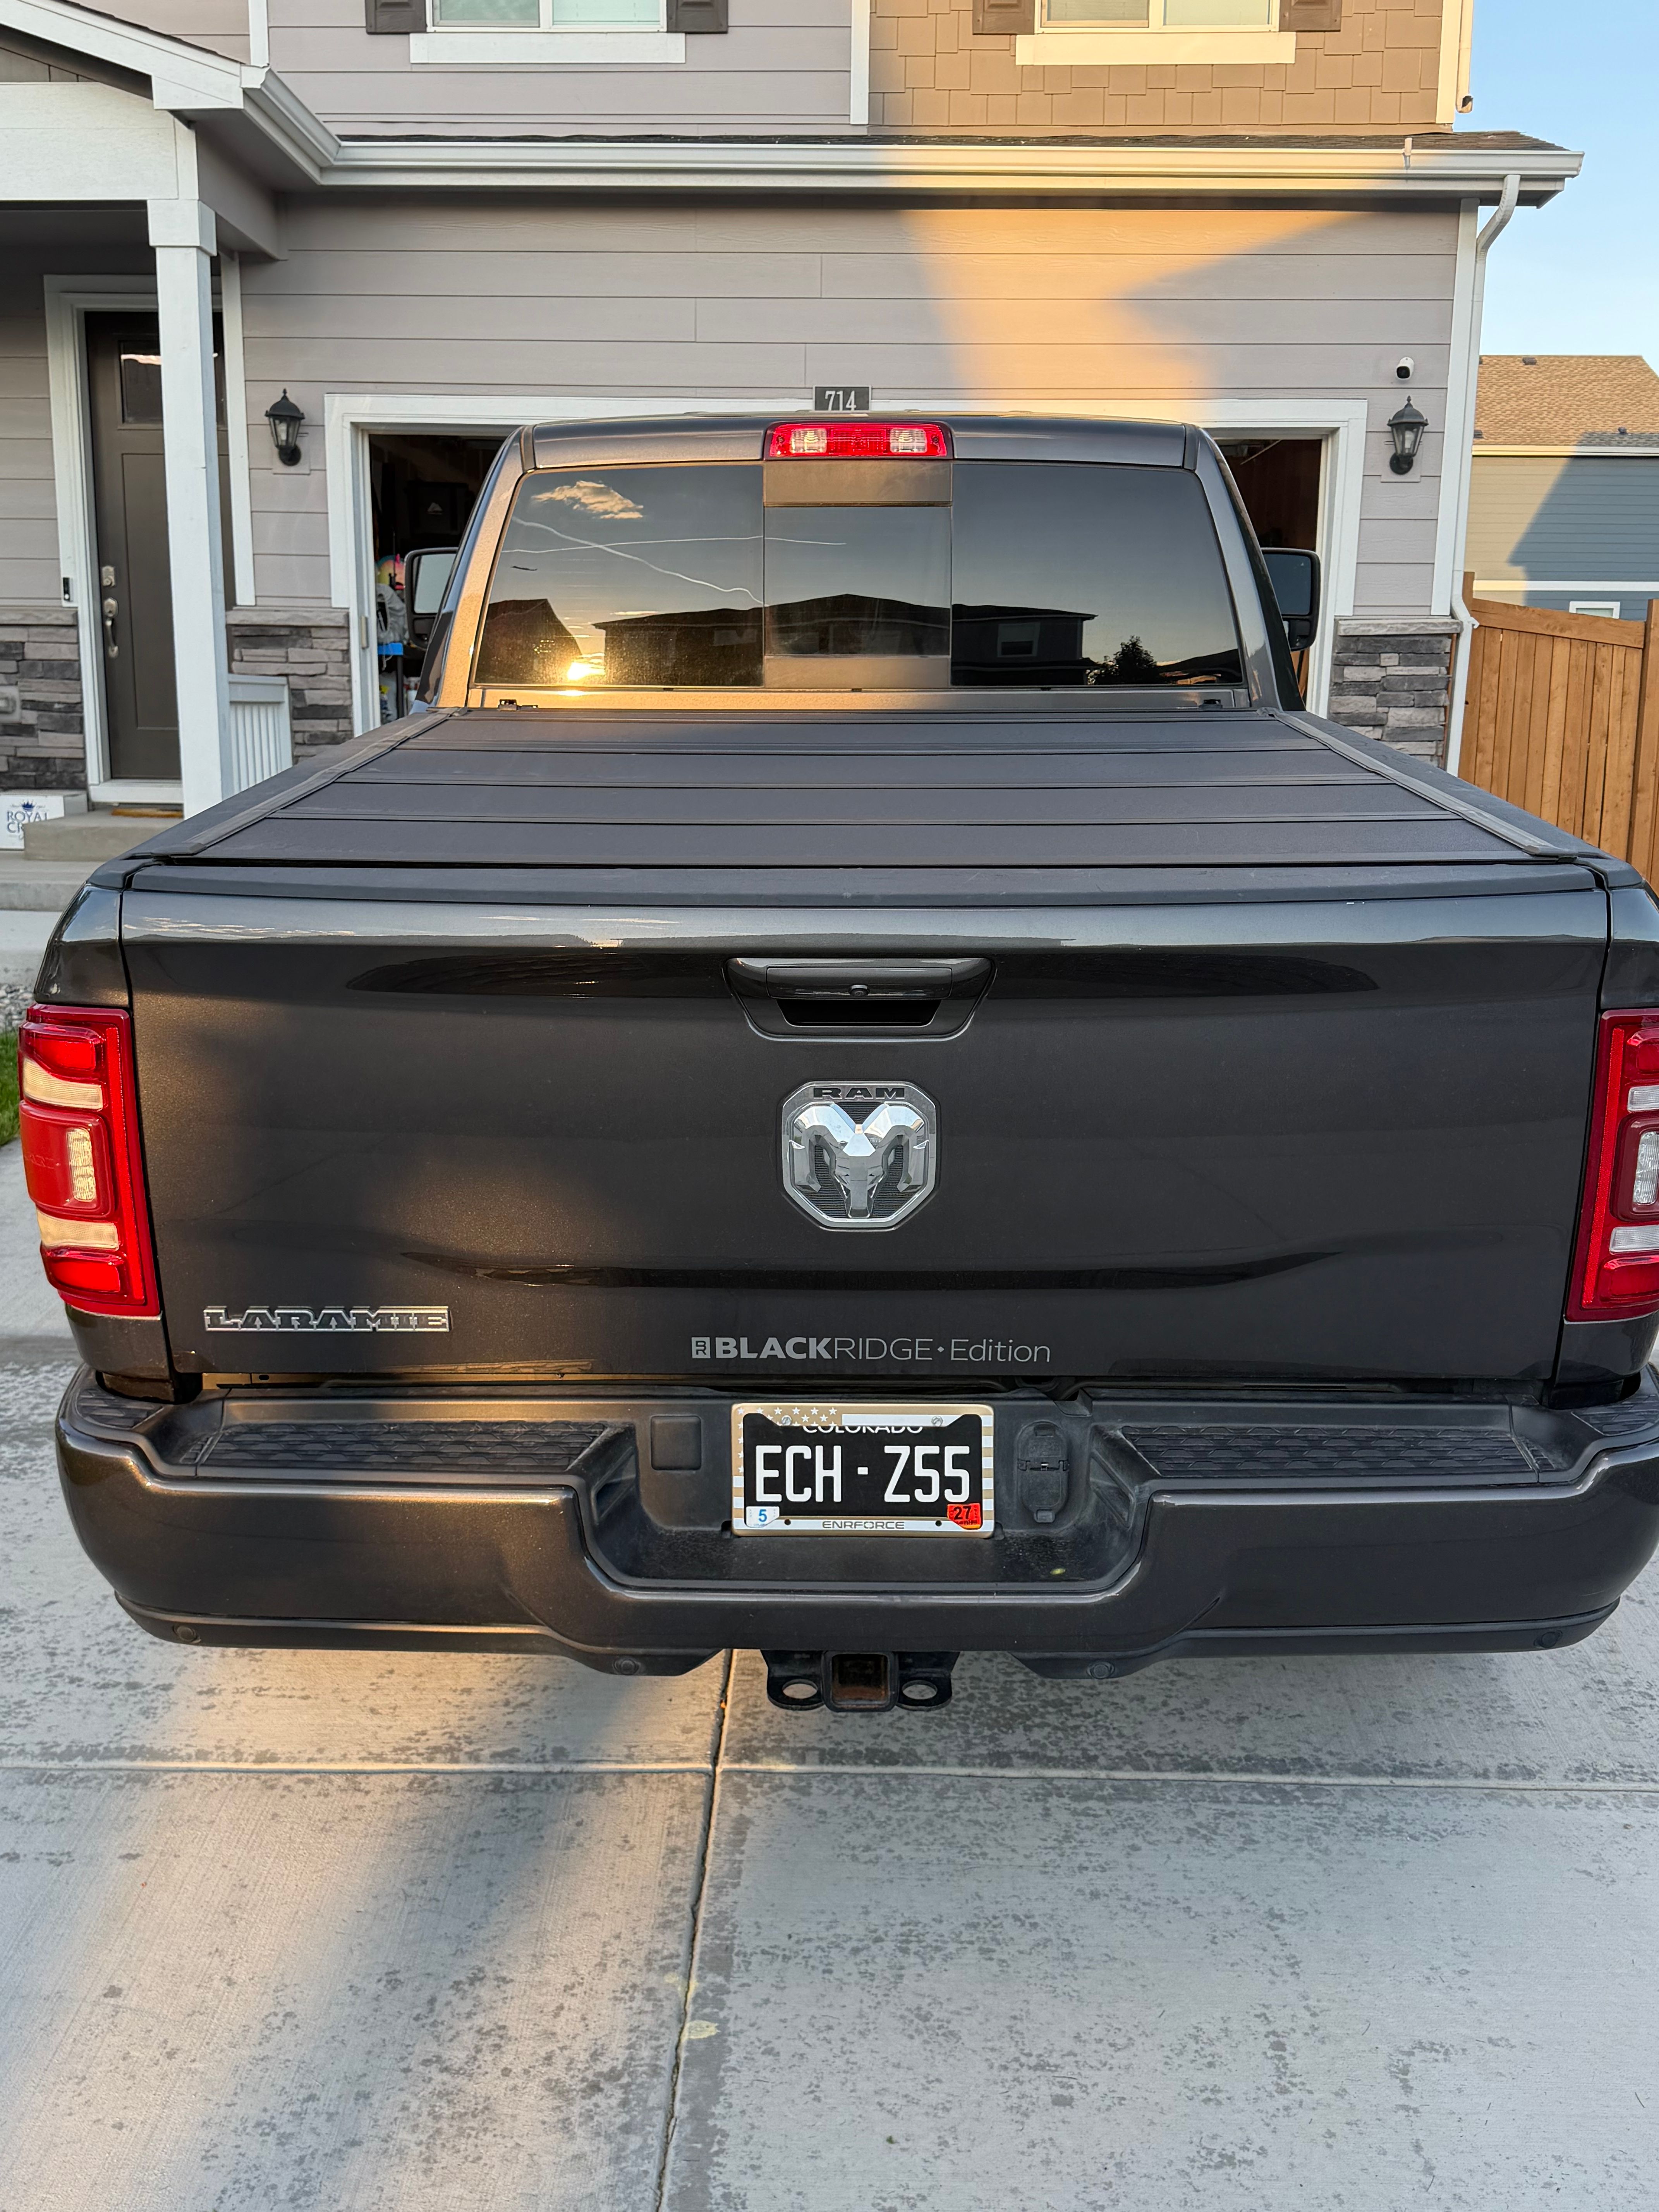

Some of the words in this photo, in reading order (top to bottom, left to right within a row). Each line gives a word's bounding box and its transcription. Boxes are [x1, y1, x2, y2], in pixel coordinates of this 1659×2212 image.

[825, 390, 856, 411] 714
[813, 1087, 905, 1099] RAM
[203, 1306, 450, 1332] LARAMIE
[951, 1339, 1050, 1362] Edition
[758, 1509, 767, 1522] 5
[953, 1506, 972, 1520] 27
[822, 1521, 905, 1529] ENRFORCE
